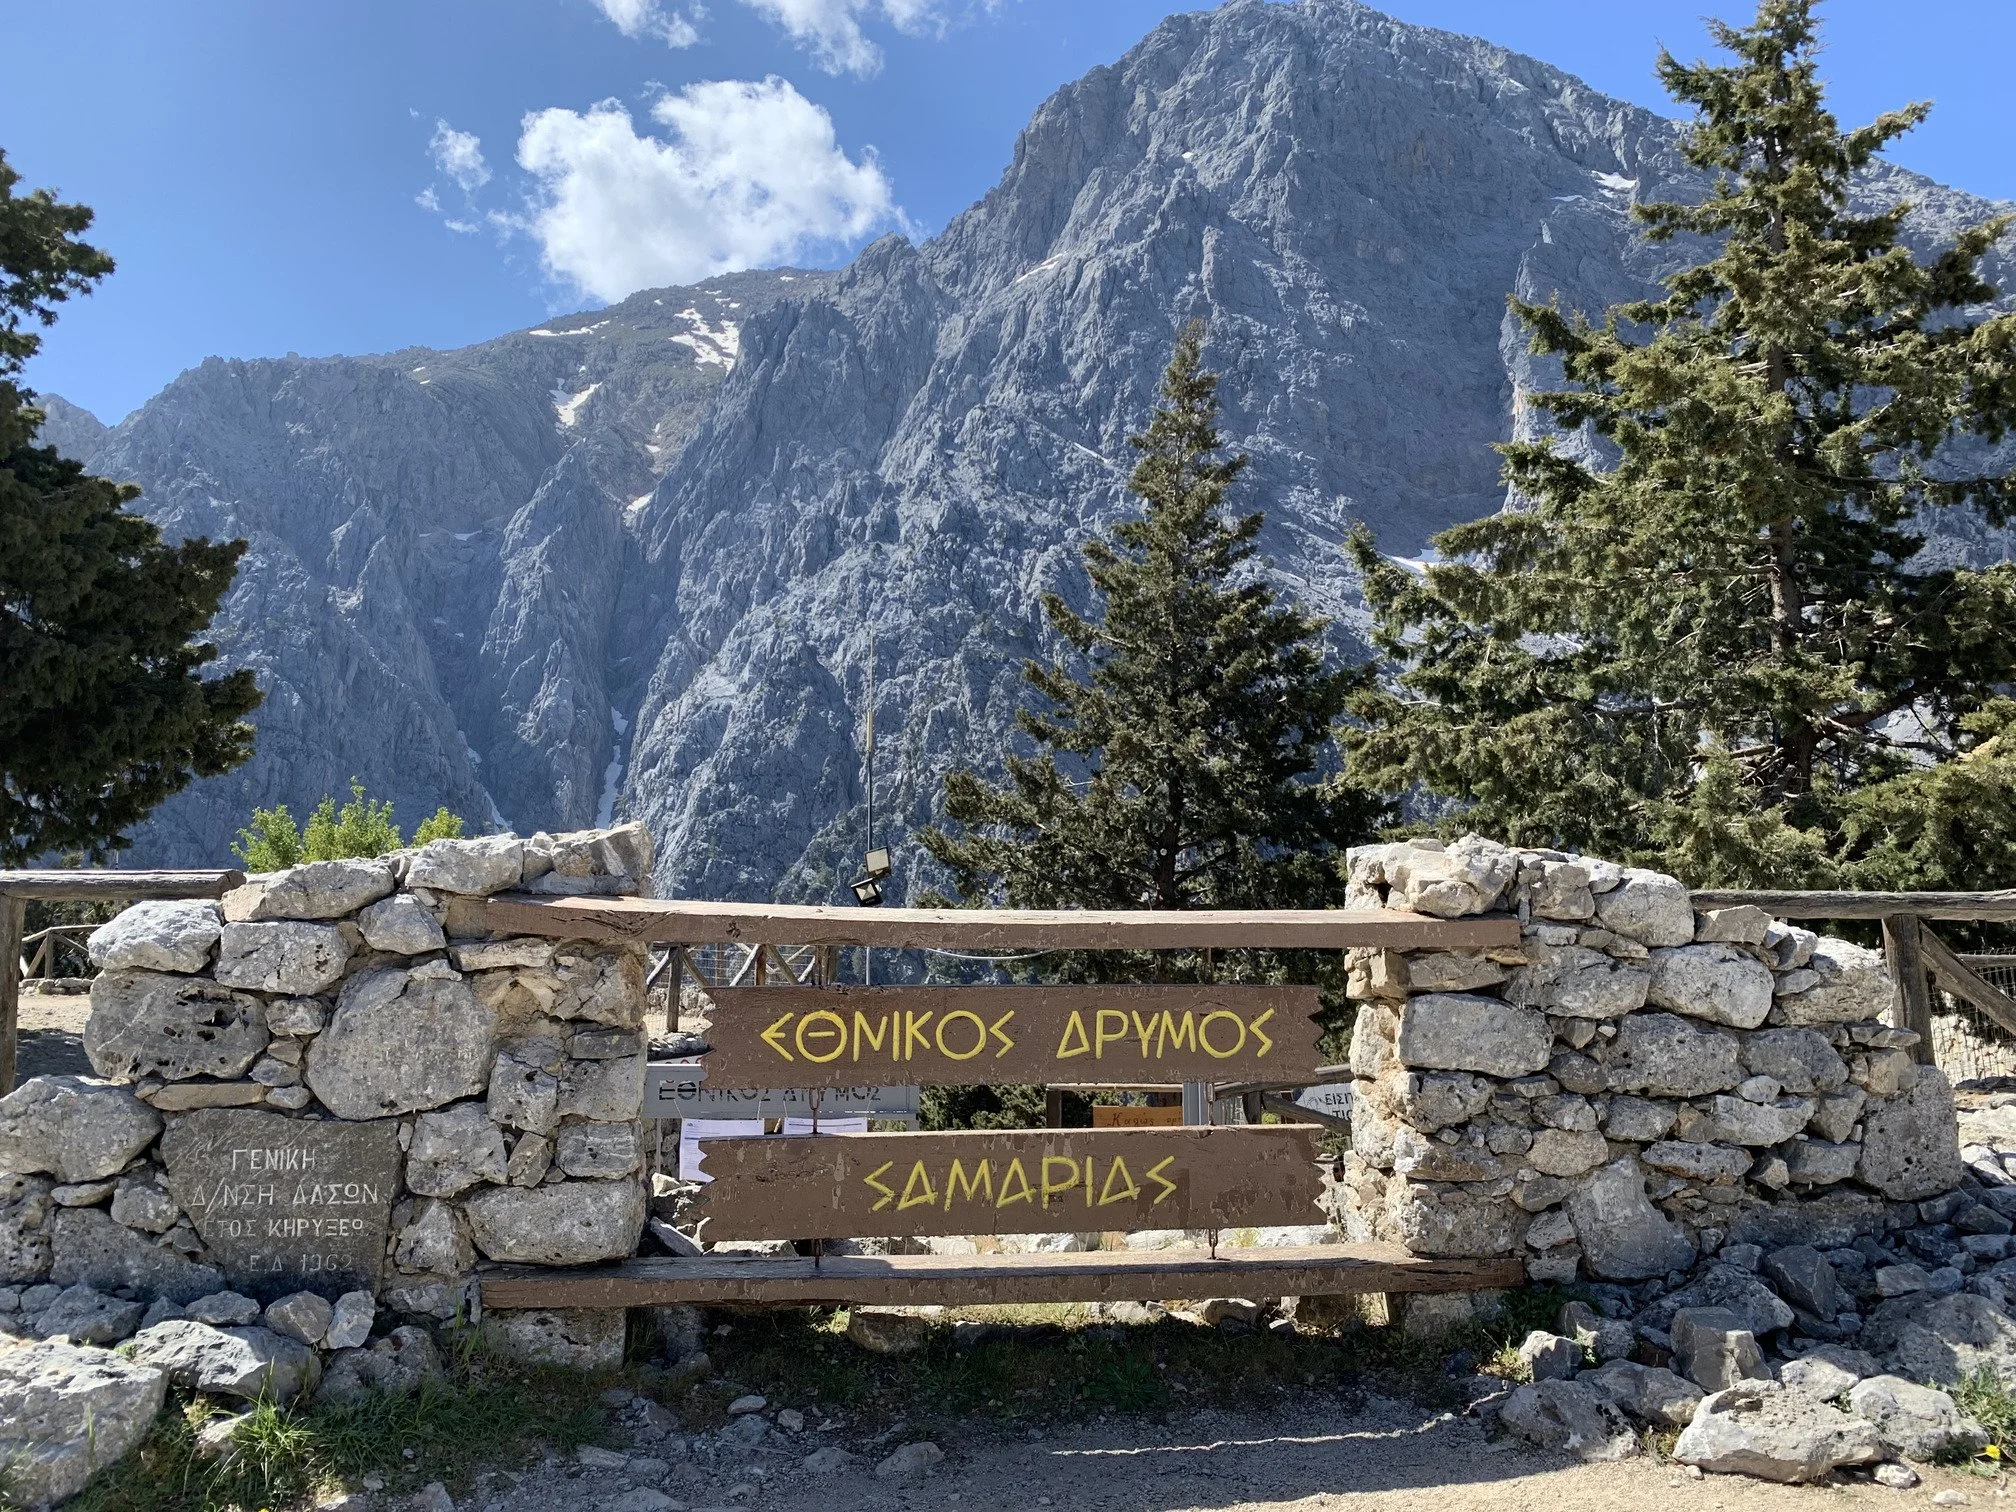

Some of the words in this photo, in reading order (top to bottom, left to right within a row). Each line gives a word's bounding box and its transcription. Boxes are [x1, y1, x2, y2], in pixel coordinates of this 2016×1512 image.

[760, 1010, 1016, 1063] ΕΘΝΙΚΟΣ
[1055, 1008, 1276, 1060] ΔΡΥΜΟΣ
[231, 1149, 316, 1171] ΓΕΝΙΚΗ
[191, 1177, 274, 1213] Δ/ΝΣΗ
[292, 1182, 378, 1206] ΔΑΣΩΝ
[863, 1155, 1176, 1211] ΣΑΜΑΡΙΑΣ
[203, 1218, 258, 1238] ΕΤΟΣ
[301, 1253, 353, 1272] 1962
